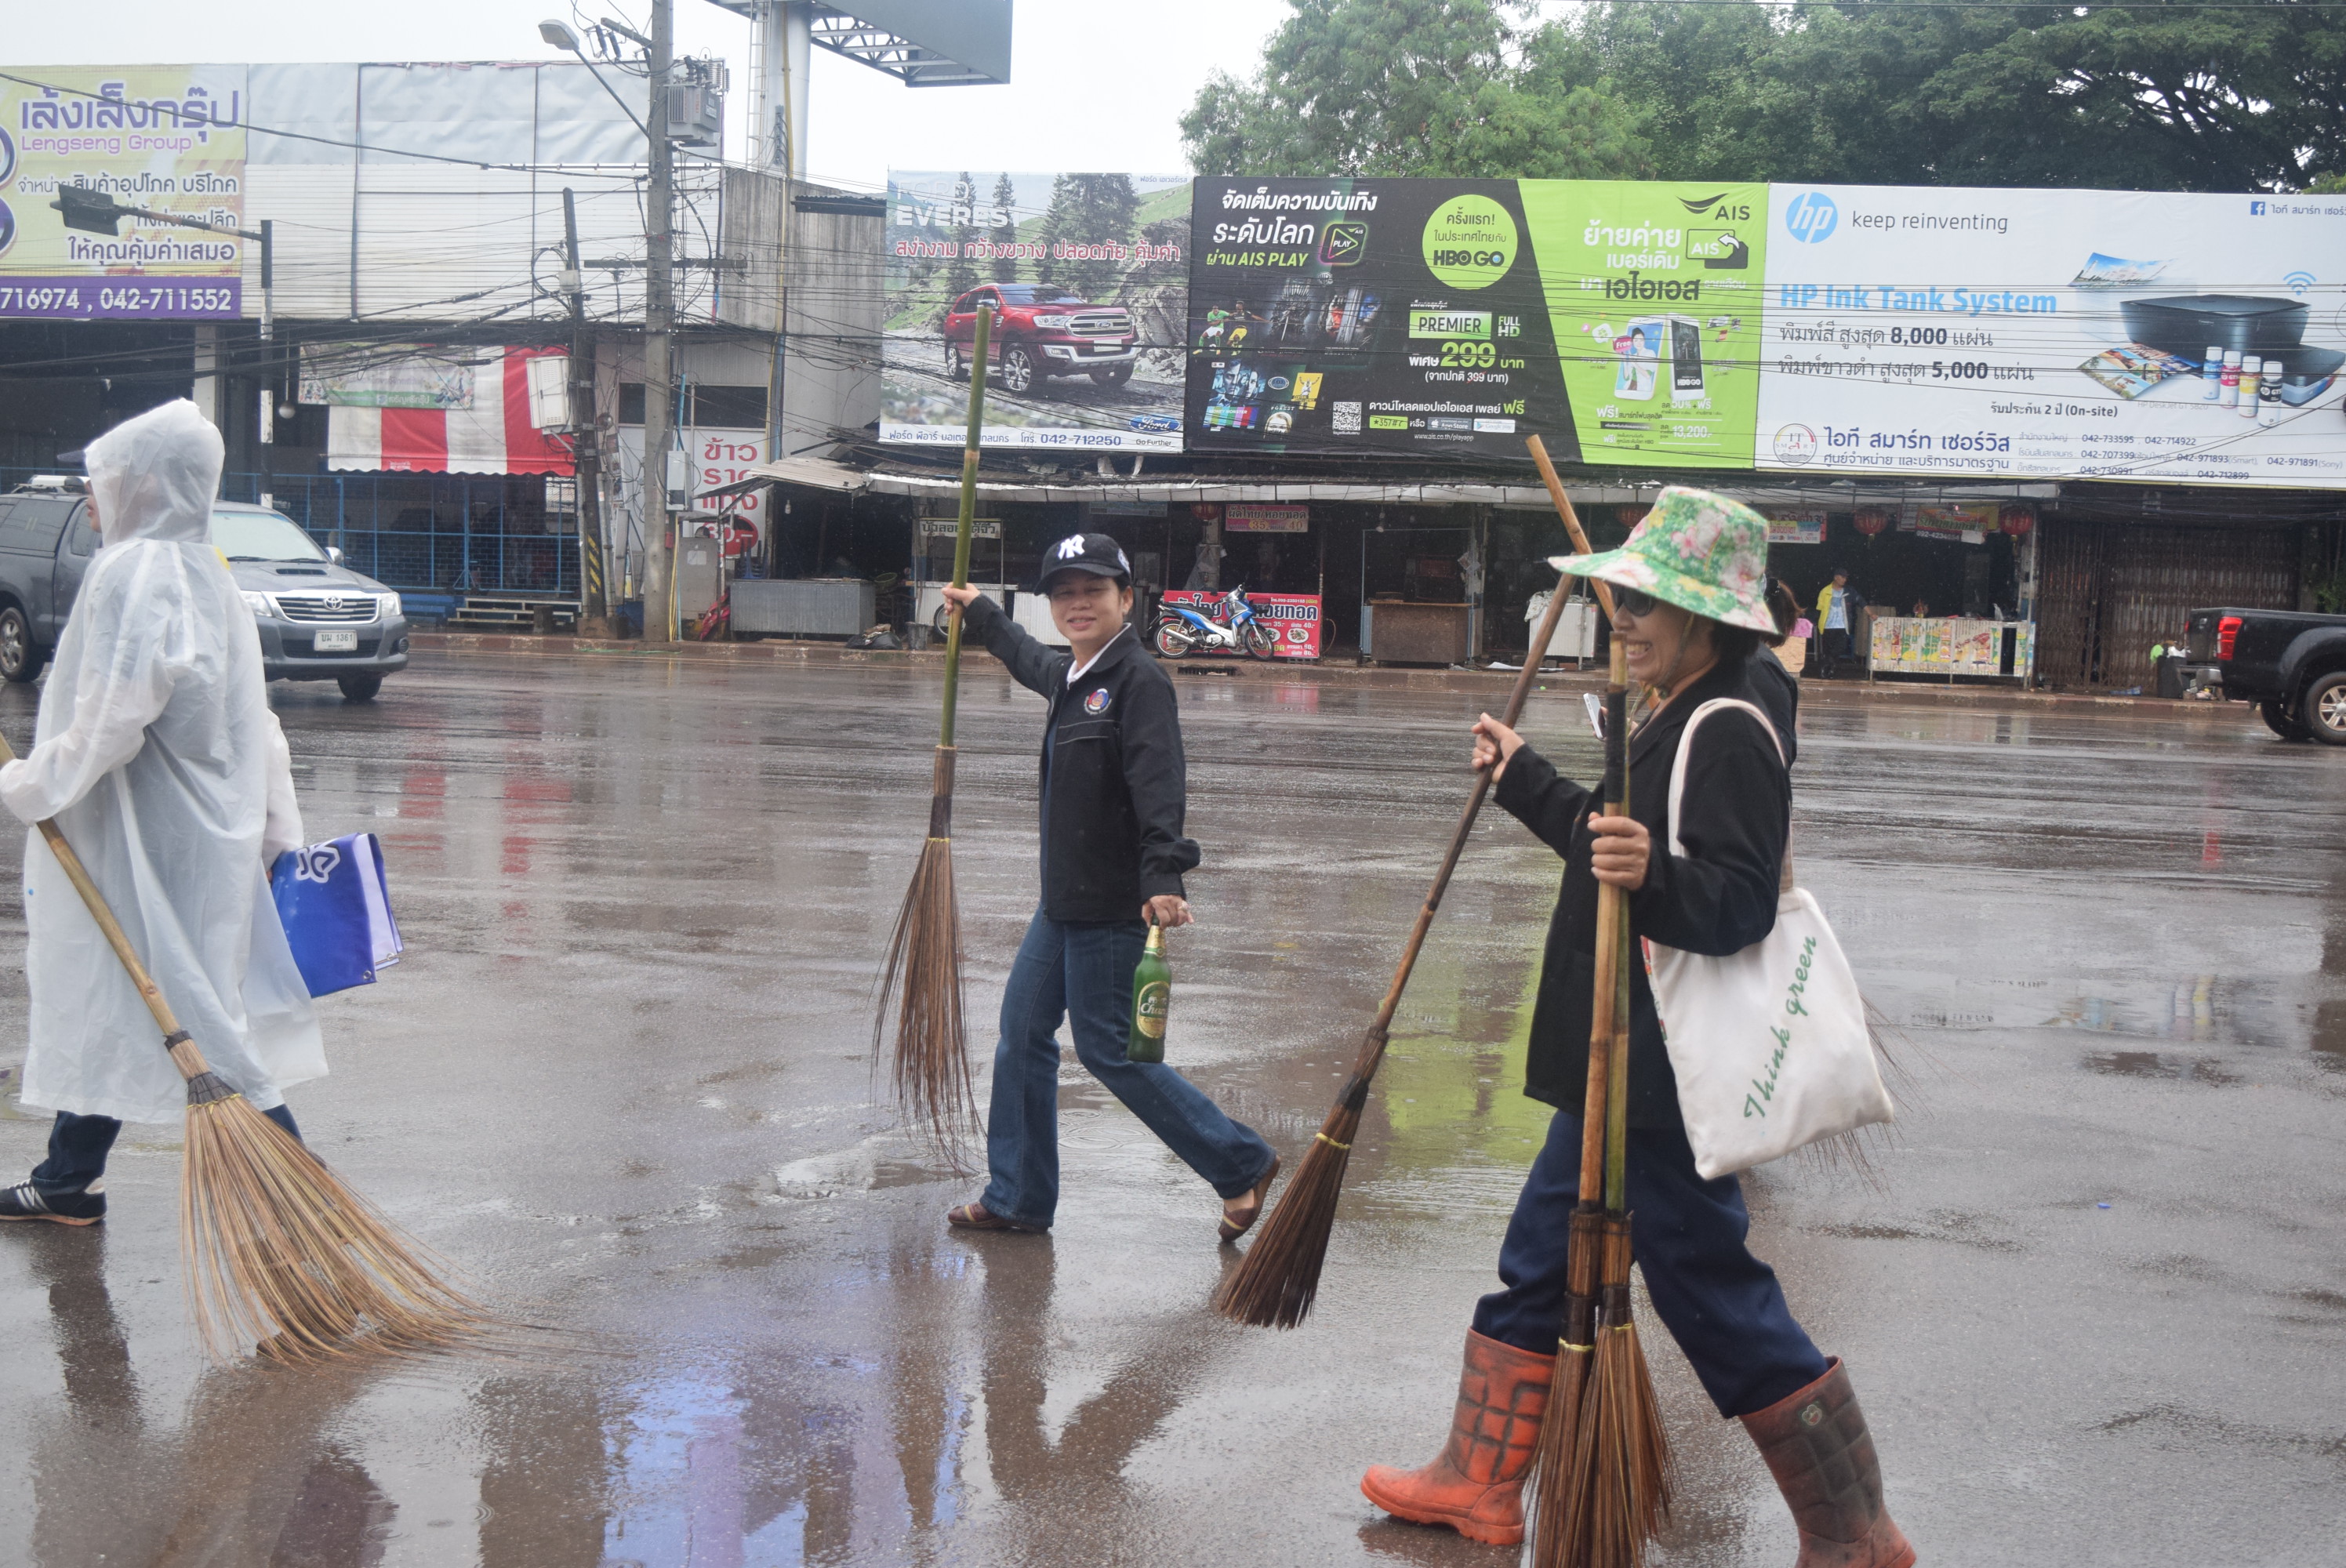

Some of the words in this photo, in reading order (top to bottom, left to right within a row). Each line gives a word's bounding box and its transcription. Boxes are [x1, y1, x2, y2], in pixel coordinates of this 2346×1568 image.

[21, 136, 121, 155] Lengseng
[129, 135, 192, 154] Group
[183, 172, 237, 193] บริโภค
[1221, 187, 1378, 212] จัดเต็มความบันเทิง
[1446, 206, 1496, 226] ครั้งแรก!
[1714, 205, 1751, 222] AIS
[1794, 193, 1832, 243] hp
[1851, 210, 1896, 231] keep
[1902, 212, 2009, 234] reinventing
[1212, 216, 1315, 245] ระดับโลก
[1583, 219, 1681, 249] ย้ายค่าย
[68, 237, 235, 266] ให้คุณคุ้มค่าเสมอ
[896, 241, 957, 258] สง่างาม
[964, 237, 1046, 260] กว้างขวาง
[1053, 239, 1127, 261] ปลอดภัย
[1135, 240, 1181, 267] คุ้มค่า
[1206, 252, 1237, 267] ผ่าน
[1239, 252, 1266, 267] AIS
[1268, 252, 1309, 267] PLAY
[1607, 248, 1680, 270] เบอร์เดิม
[1690, 241, 1720, 256] AIS
[1605, 270, 1701, 301] เอไอเอส
[100, 288, 233, 311] 042-711552
[1780, 283, 1818, 308] HP
[1825, 284, 1870, 310] Ink
[1877, 286, 1945, 312] Tank
[1952, 288, 2057, 318] System
[1418, 316, 1482, 333] PREMIER
[1498, 315, 1521, 326] FULL
[1498, 325, 1521, 337] HD
[1779, 320, 1836, 343] พิมพ์สี
[1839, 328, 1886, 350] สูงสุด
[1890, 326, 1948, 346] 8,000
[1952, 328, 1994, 347] แผ่น
[1440, 341, 1496, 368] 299
[1500, 358, 1525, 369] บาท
[1487, 373, 1509, 386] บาท)
[1879, 363, 1927, 384] สูงสุด
[1930, 361, 1989, 380] 5,000
[1992, 361, 2035, 382] แผ่น
[1502, 398, 1525, 415] ฟรี
[1596, 405, 1619, 419] ฟรี!
[1990, 402, 2042, 416] รับประกัน
[2045, 405, 2052, 415] 2
[2065, 405, 2119, 418] (On-site)
[703, 437, 758, 462] ข้าว
[1040, 433, 1122, 446] 042-712250
[1823, 426, 1860, 448] ไอที
[1868, 428, 1932, 450] สมาร์ท
[1941, 430, 2011, 453] เซอร์วิส
[2082, 434, 2135, 444] 042-733595
[2144, 436, 2196, 446] 042-714922
[1743, 1025, 1790, 1119] Think
[1786, 935, 1817, 1017] green
